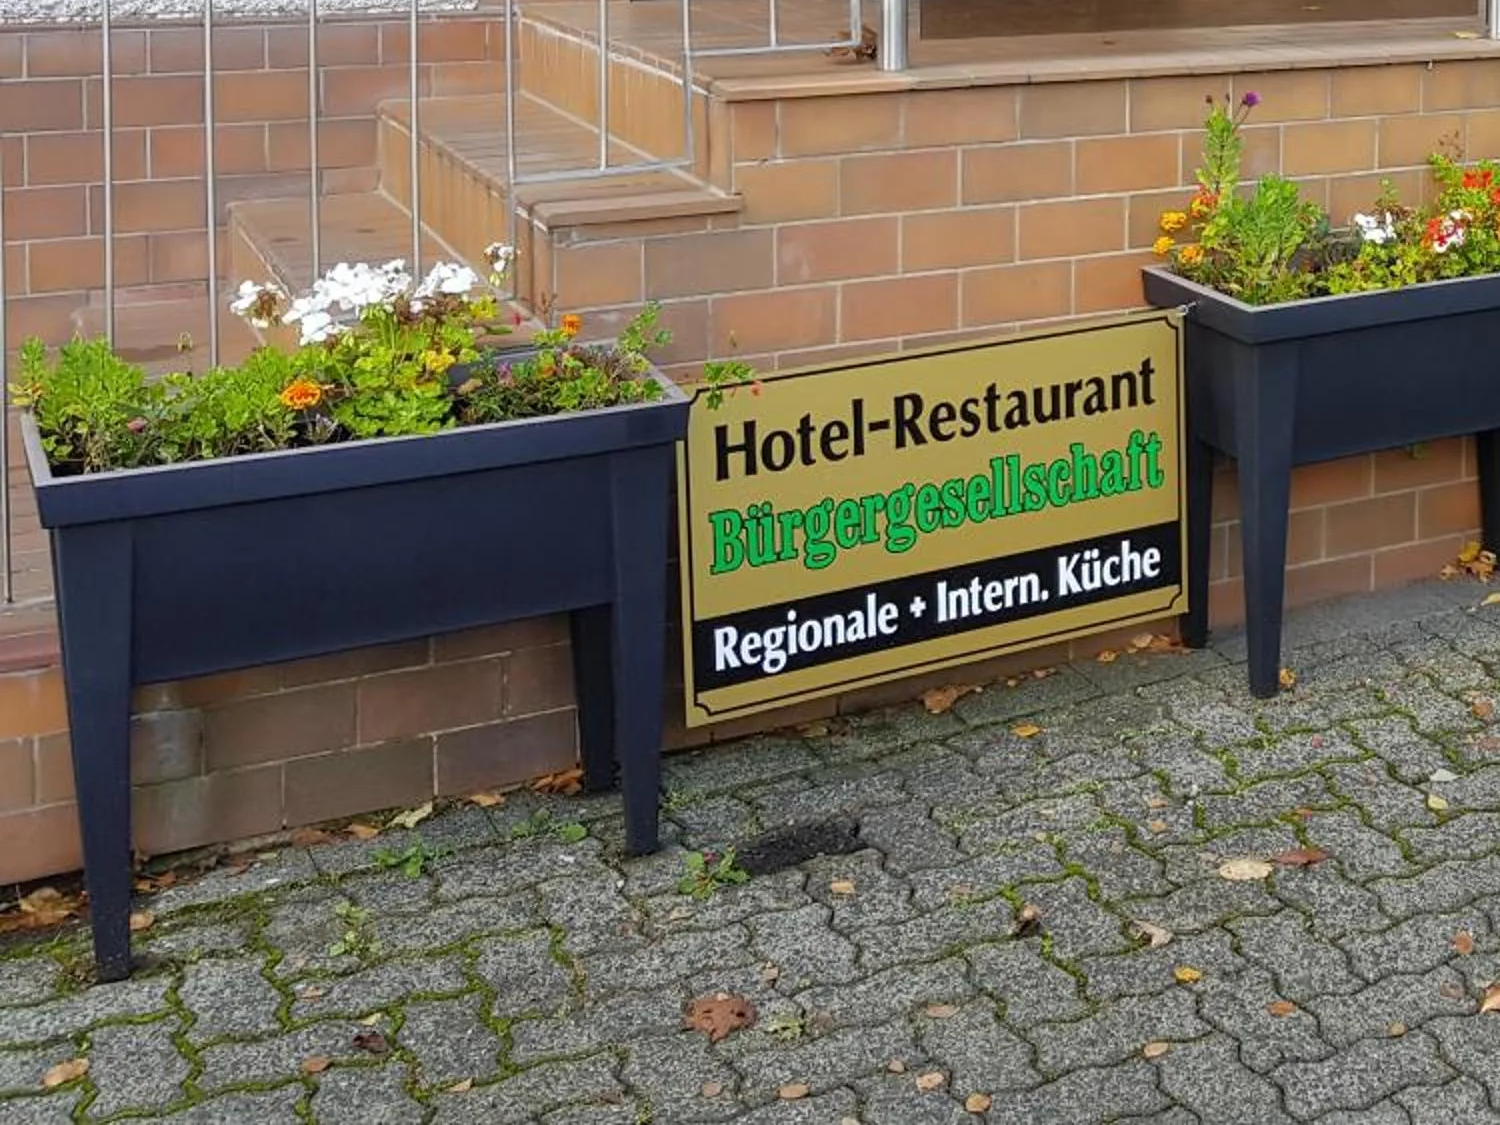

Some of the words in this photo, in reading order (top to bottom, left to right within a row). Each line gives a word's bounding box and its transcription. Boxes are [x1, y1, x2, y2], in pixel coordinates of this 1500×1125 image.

[714, 357, 1156, 481] Hotel-Restaurant
[709, 429, 1165, 575] Bürgergesellschaft
[714, 593, 899, 674] Regionale
[910, 595, 927, 619] +
[936, 571, 1049, 623] Intern.
[1057, 539, 1162, 598] Küche
